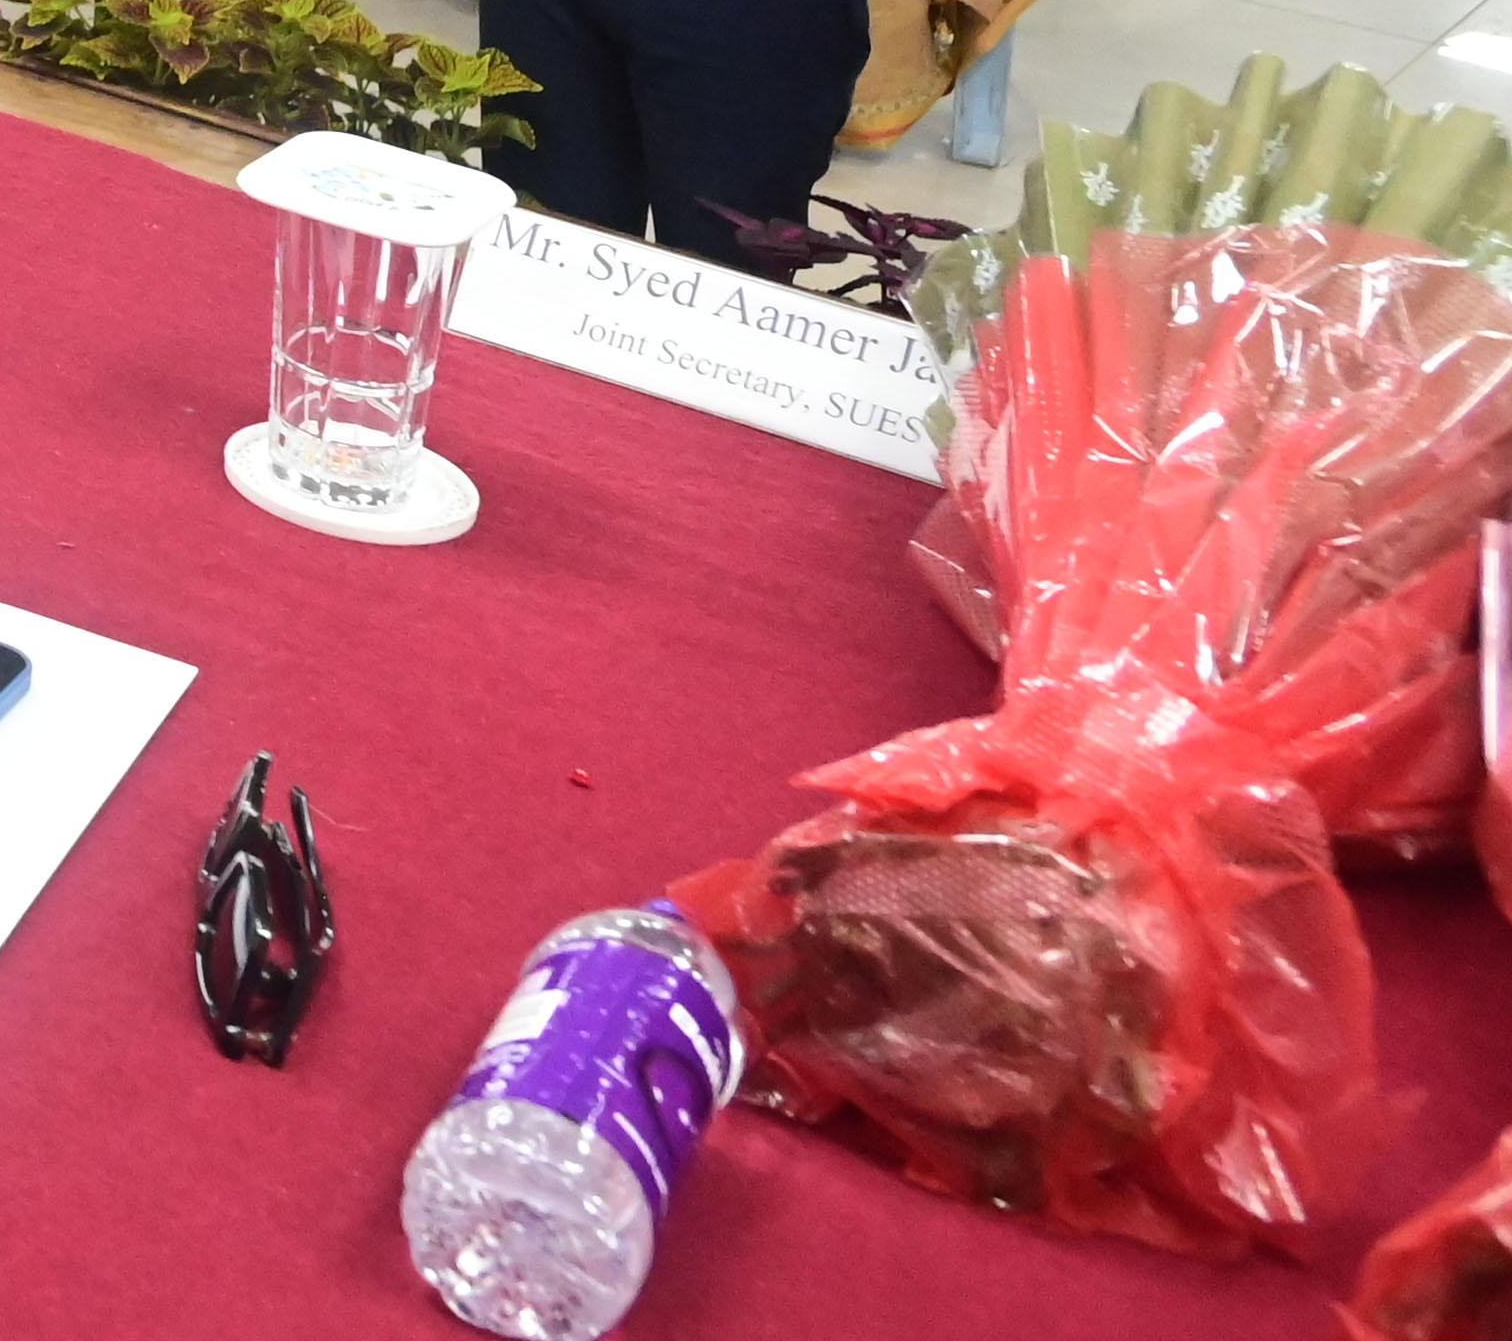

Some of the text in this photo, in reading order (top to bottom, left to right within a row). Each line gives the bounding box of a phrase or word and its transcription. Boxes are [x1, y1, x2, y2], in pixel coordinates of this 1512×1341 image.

[488, 212, 938, 385] Mr. Syed Aamer Ja
[572, 312, 926, 444] Joint Secretary, SUES
